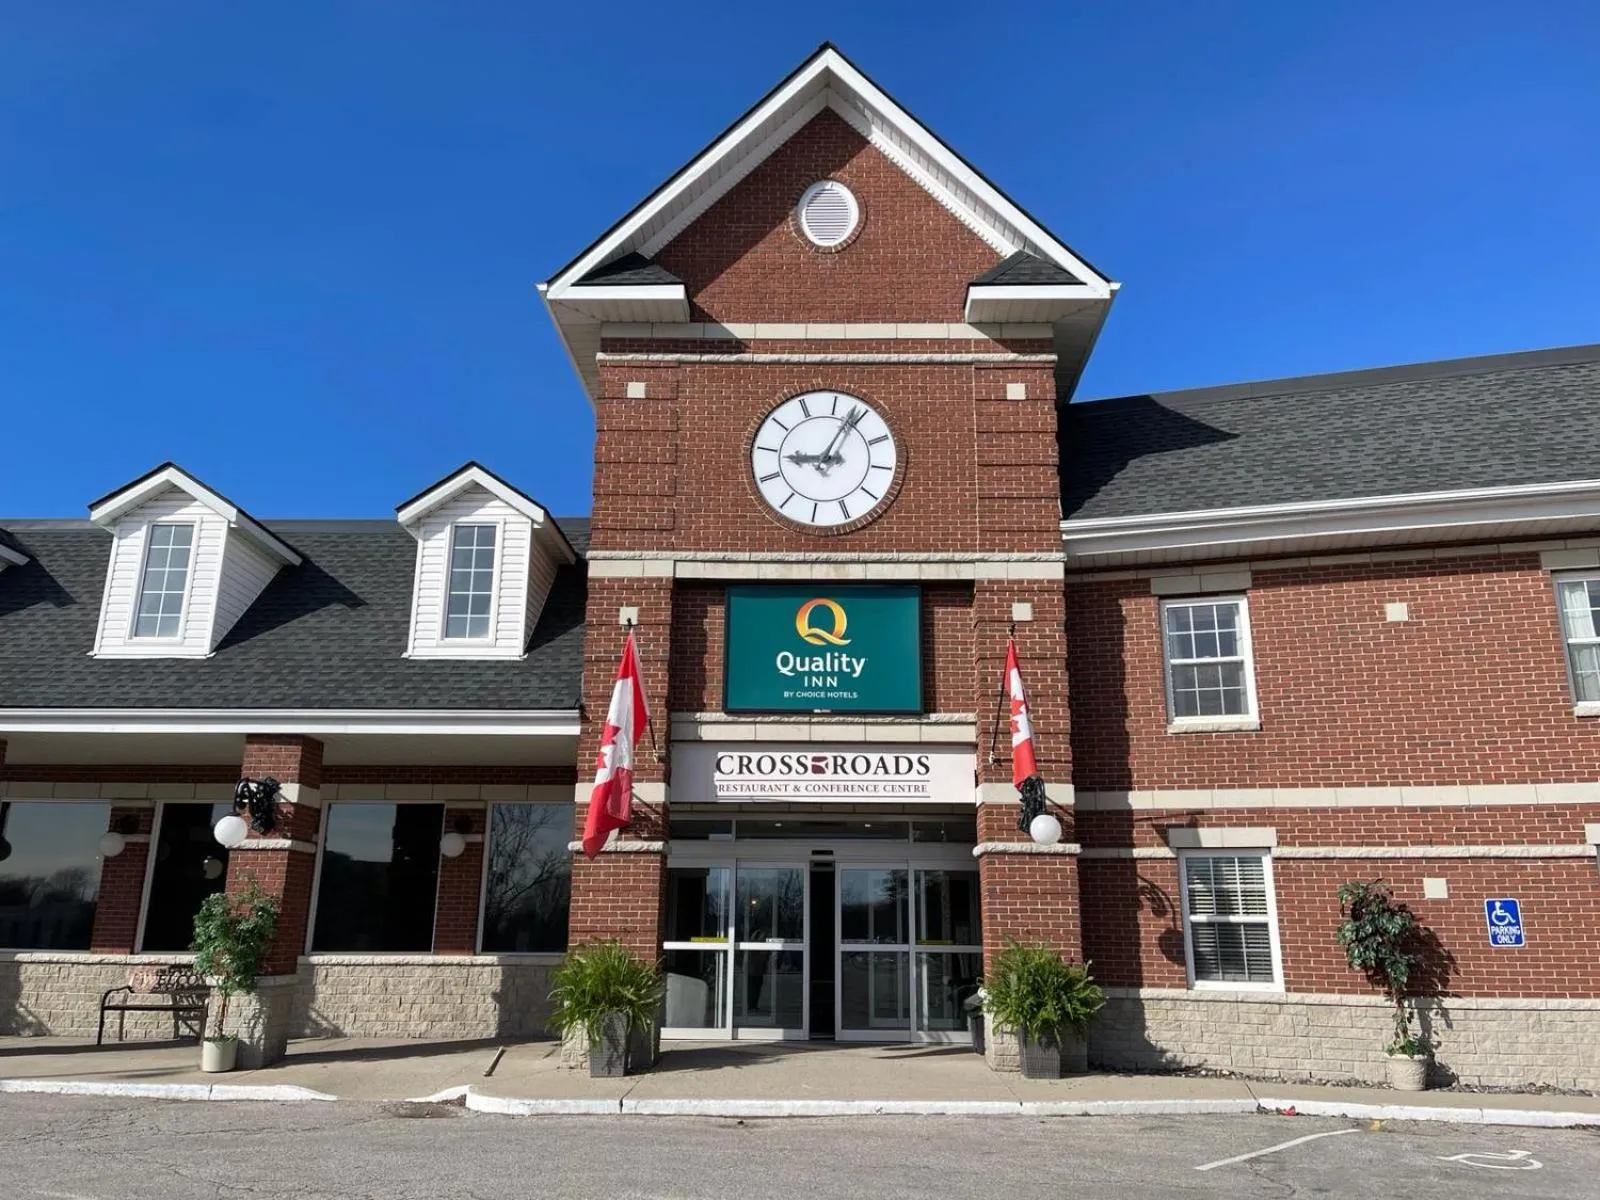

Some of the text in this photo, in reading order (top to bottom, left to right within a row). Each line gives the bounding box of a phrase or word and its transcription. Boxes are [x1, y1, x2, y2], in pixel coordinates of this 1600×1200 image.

[796, 597, 852, 645] Q
[776, 651, 866, 678] Quality
[804, 676, 838, 687] INN
[827, 691, 858, 699] HOTELS
[715, 754, 930, 775] CROSS ROADS
[718, 783, 928, 793] RESTAURANT & CONFERENCE CENTRE
[1490, 926, 1520, 935] PARKING
[1497, 934, 1516, 944] ONLY
